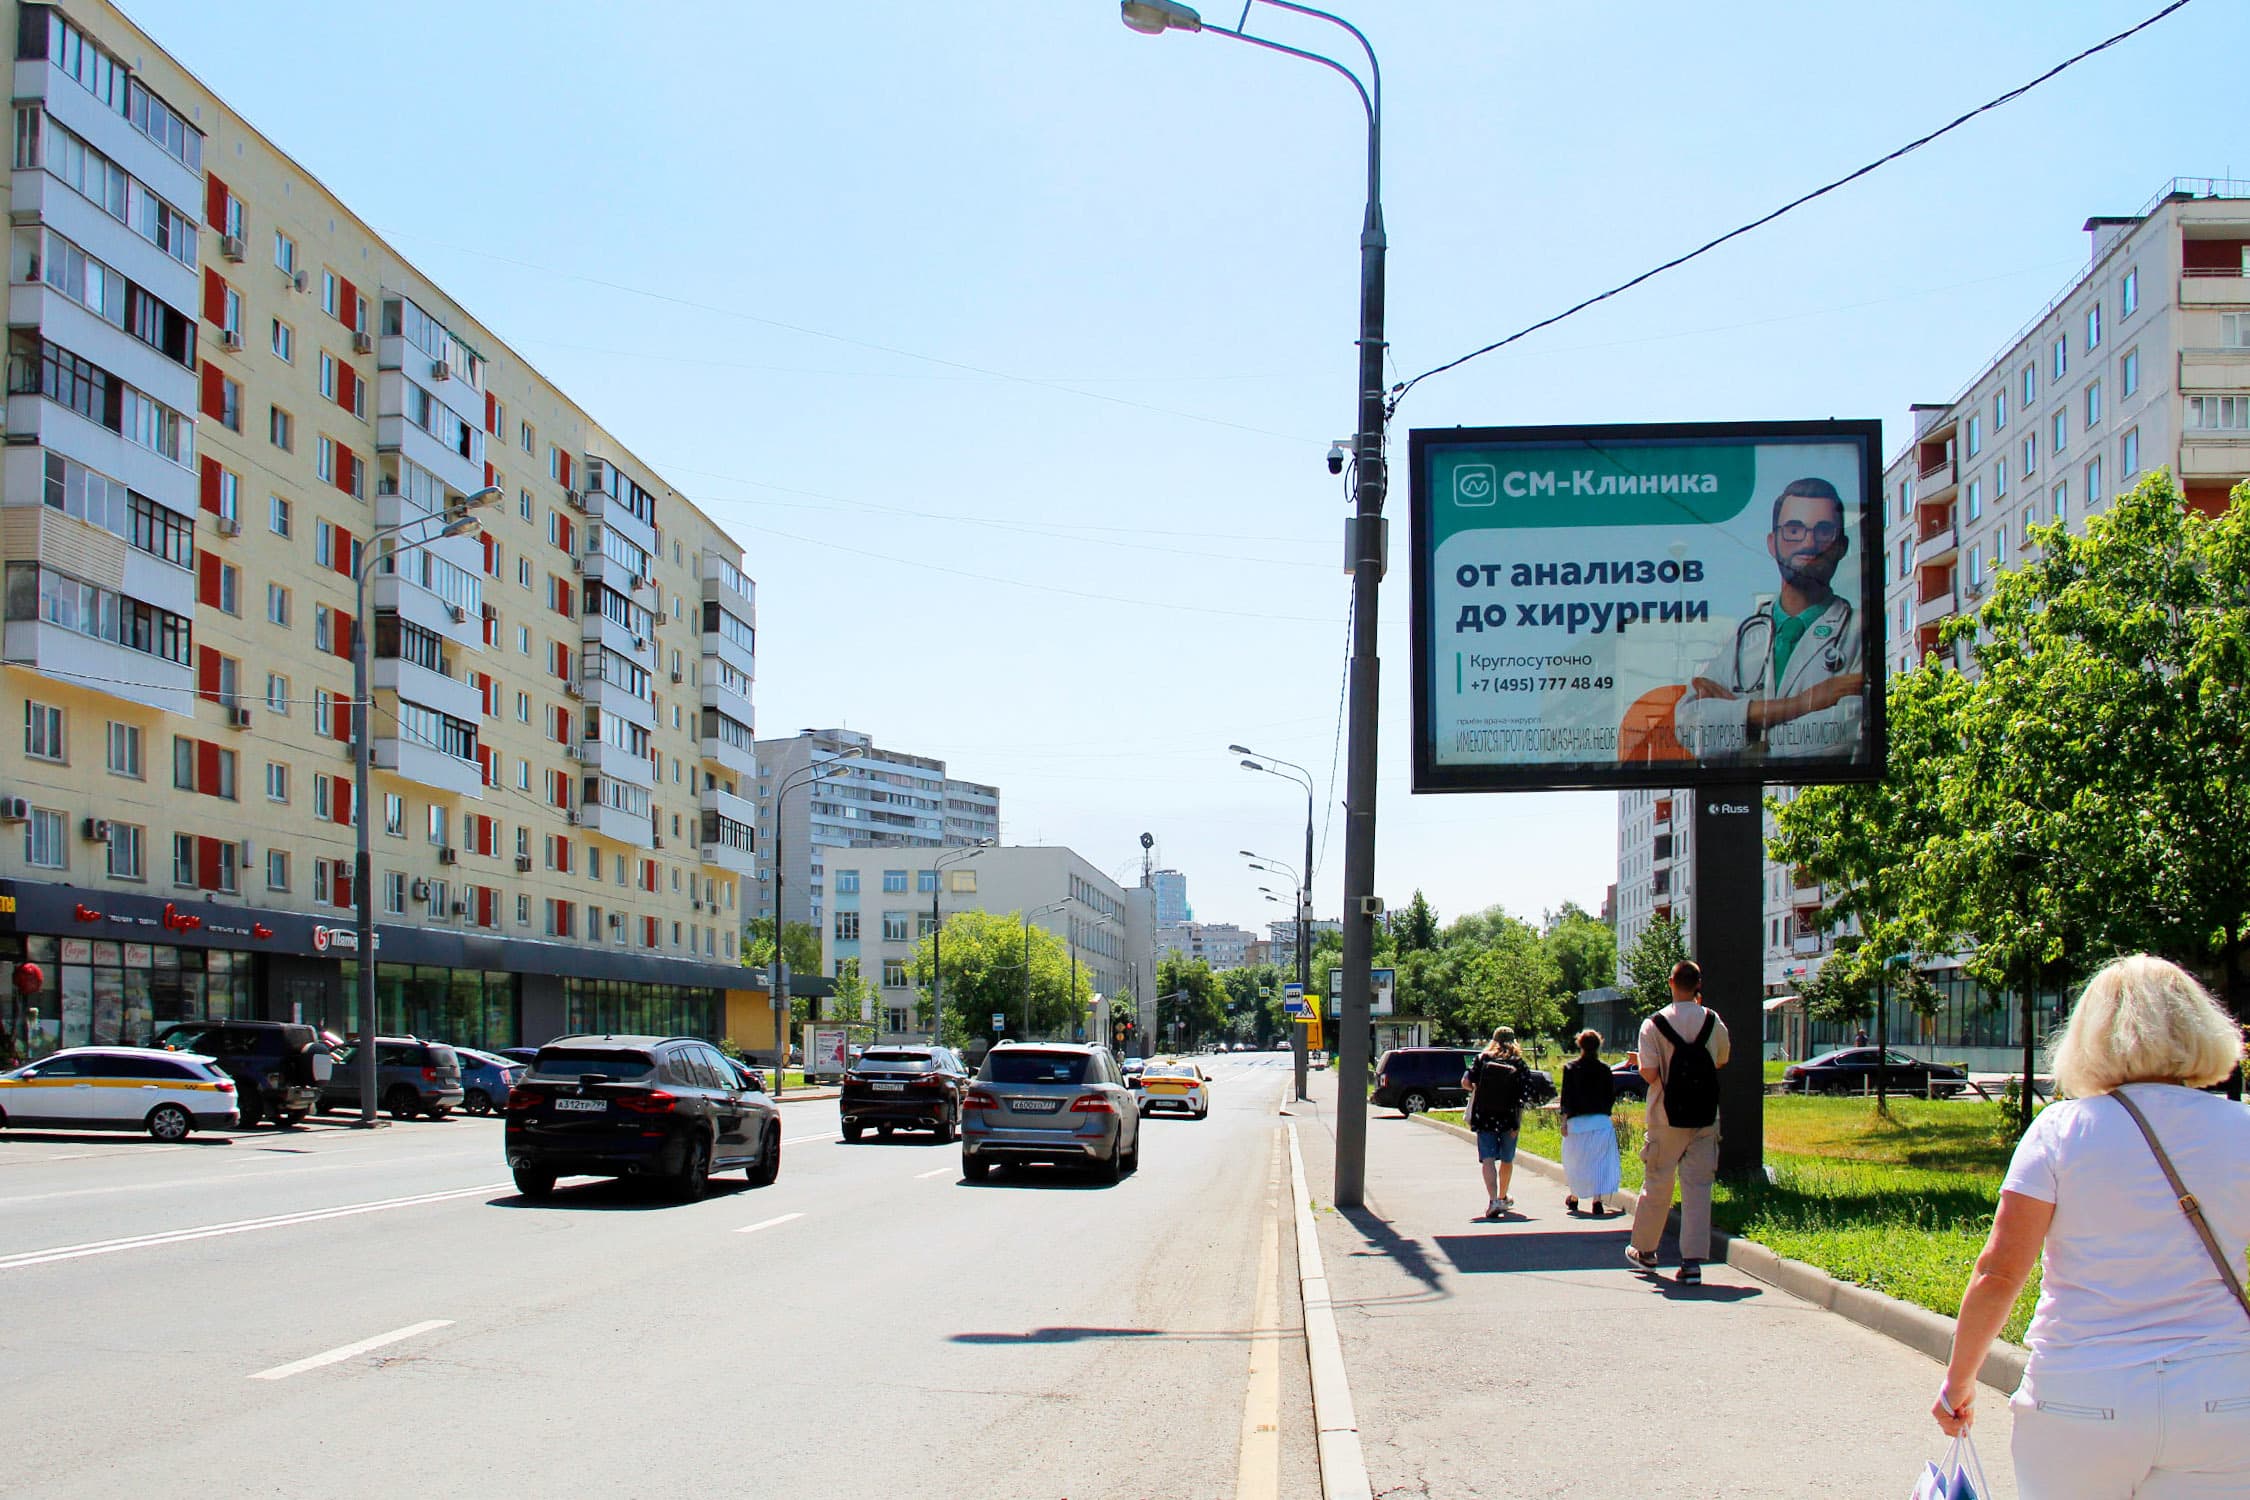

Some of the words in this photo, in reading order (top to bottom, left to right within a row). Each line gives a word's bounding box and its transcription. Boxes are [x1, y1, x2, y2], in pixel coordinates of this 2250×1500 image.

[1503, 470, 1718, 497] СМ-Клиника
[1456, 564, 1501, 588] от
[1510, 557, 1705, 586] анализов
[1456, 603, 1507, 634] до
[1516, 599, 1709, 633] хирургии
[1470, 654, 1592, 670] Круглосуточно
[1471, 679, 1489, 692] +7
[1494, 677, 1534, 692] (495)
[1538, 678, 1566, 690] 777
[1570, 677, 1590, 690] 48
[1594, 676, 1614, 689] 49
[1722, 803, 1750, 814] Russ
